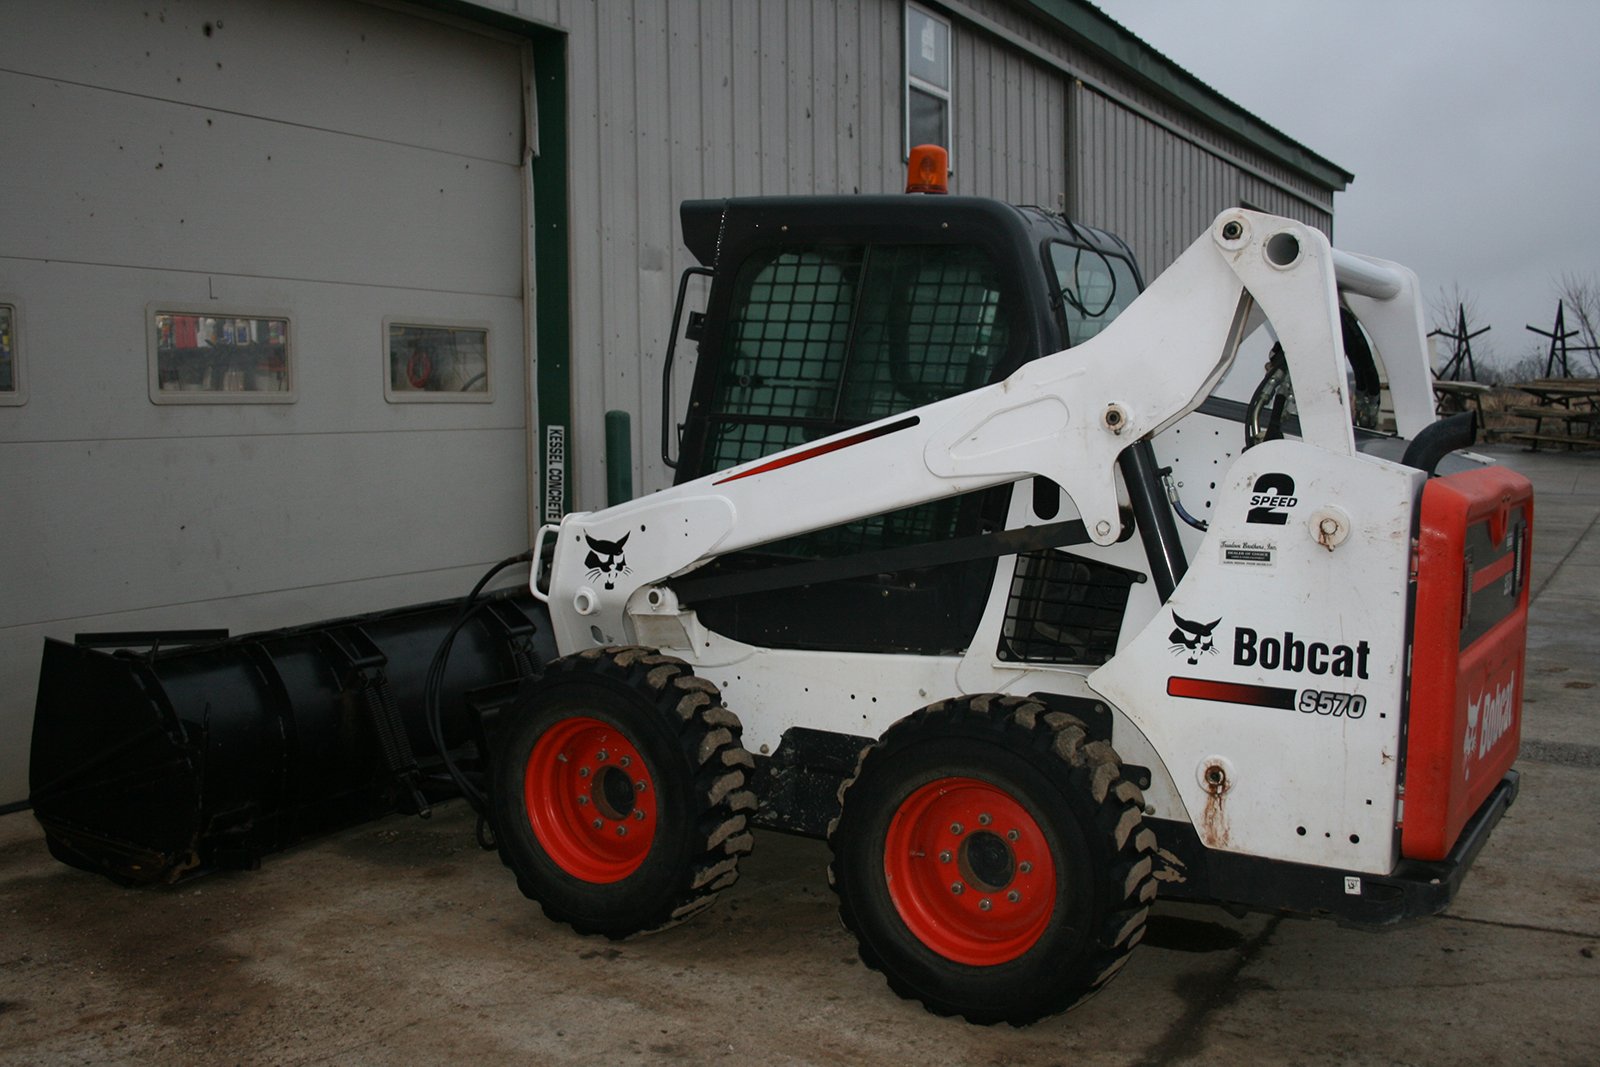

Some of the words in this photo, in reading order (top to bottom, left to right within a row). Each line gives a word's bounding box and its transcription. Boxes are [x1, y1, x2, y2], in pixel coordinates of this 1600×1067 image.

[548, 428, 563, 466] KESSEL
[547, 468, 563, 519] CONCRETE
[1246, 472, 1296, 526] 2
[1249, 495, 1299, 508] SPEED
[1233, 626, 1371, 680] Bobcat
[1299, 688, 1367, 719] S570
[1479, 670, 1515, 760] Bobcat
